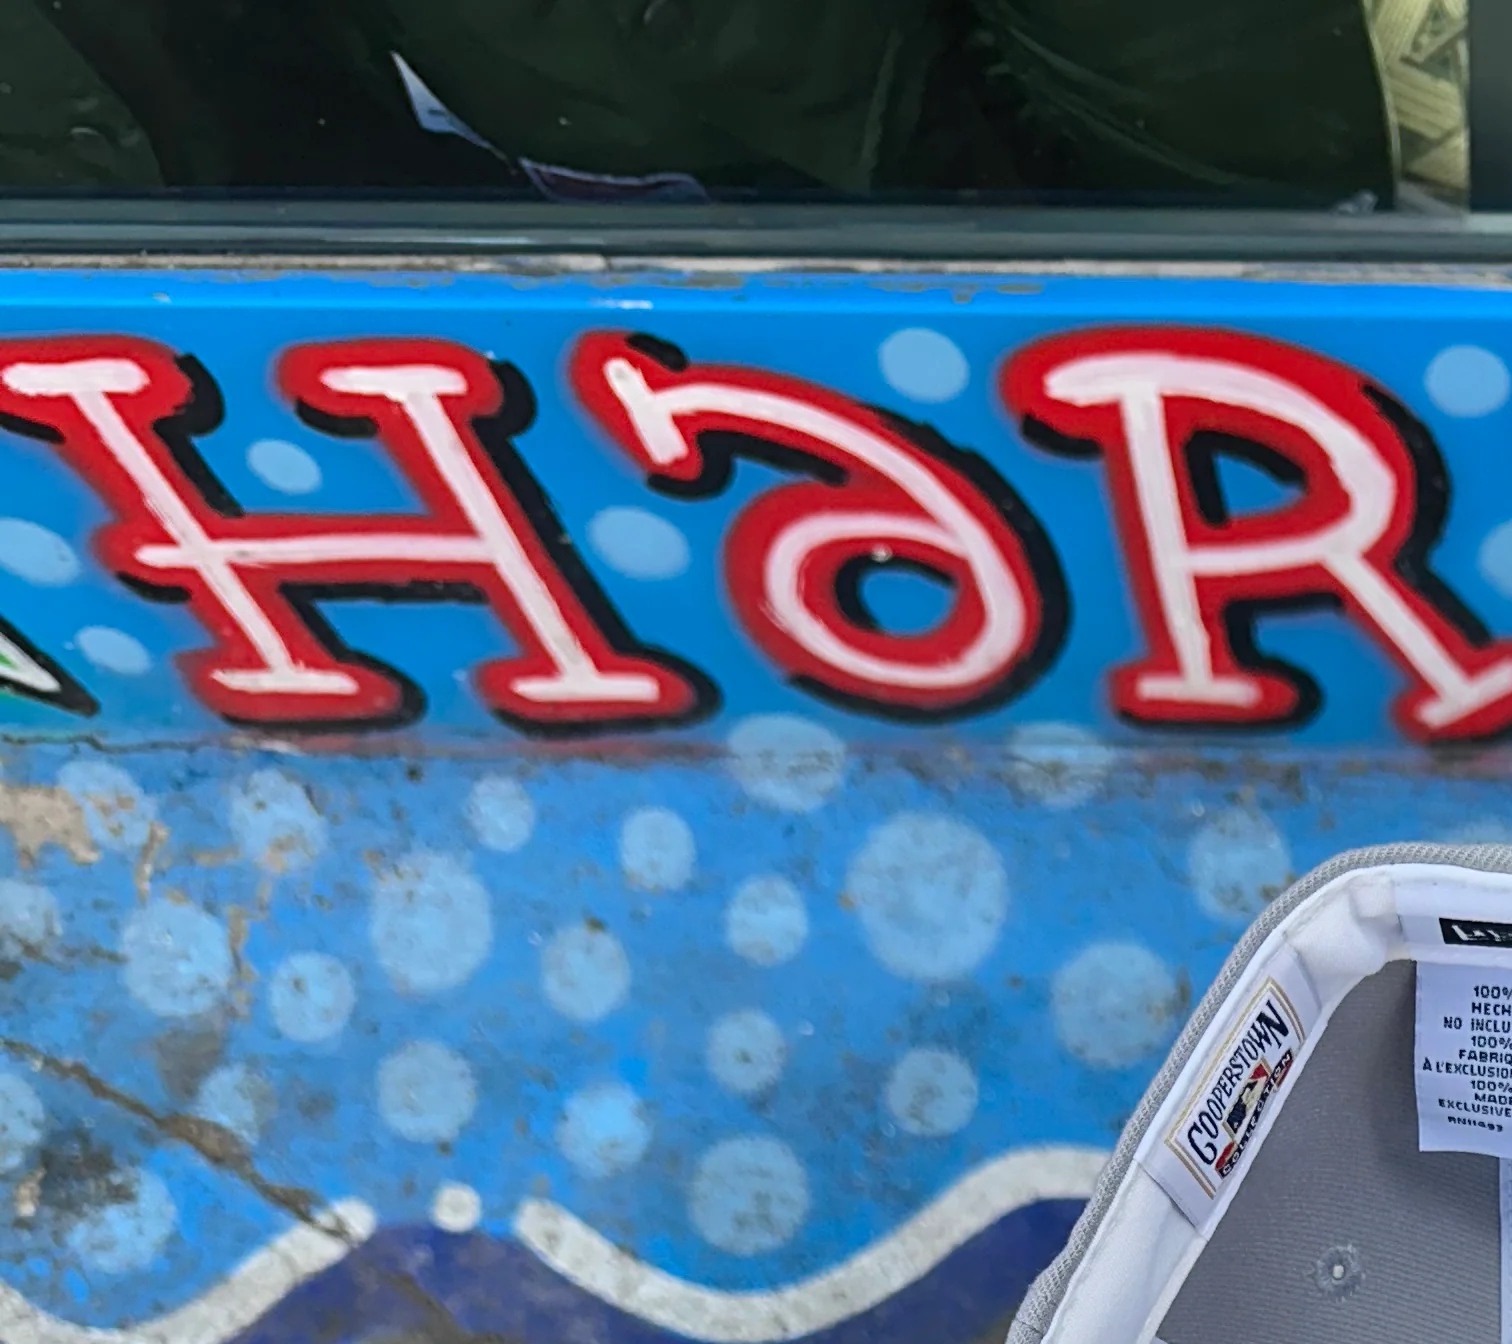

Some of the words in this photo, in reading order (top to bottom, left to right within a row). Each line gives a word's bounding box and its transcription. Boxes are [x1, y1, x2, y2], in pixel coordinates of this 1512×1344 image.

[1443, 1017, 1462, 1030] NO
[1187, 999, 1290, 1166] COOPERSTOWN
[1438, 1098, 1512, 1118] EXCLUSIVE
